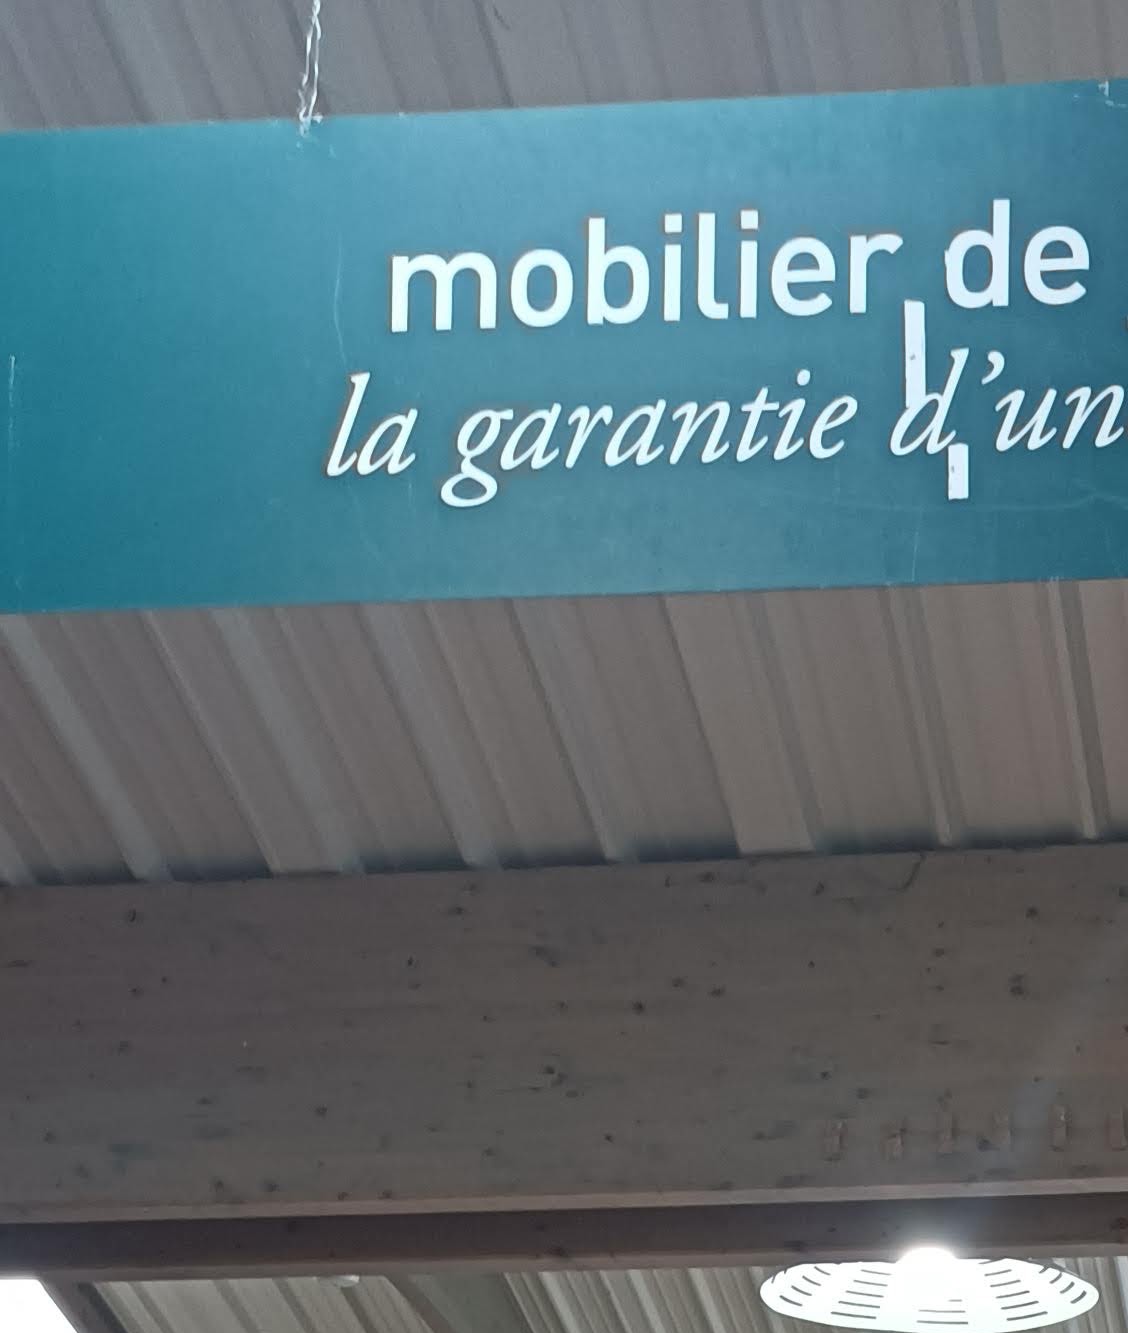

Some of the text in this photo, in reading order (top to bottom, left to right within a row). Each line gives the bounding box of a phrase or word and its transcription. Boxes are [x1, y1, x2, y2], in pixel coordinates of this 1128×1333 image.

[390, 209, 903, 332] mobilier
[944, 198, 1090, 308] de
[326, 371, 418, 476] la
[440, 369, 858, 507] garantie
